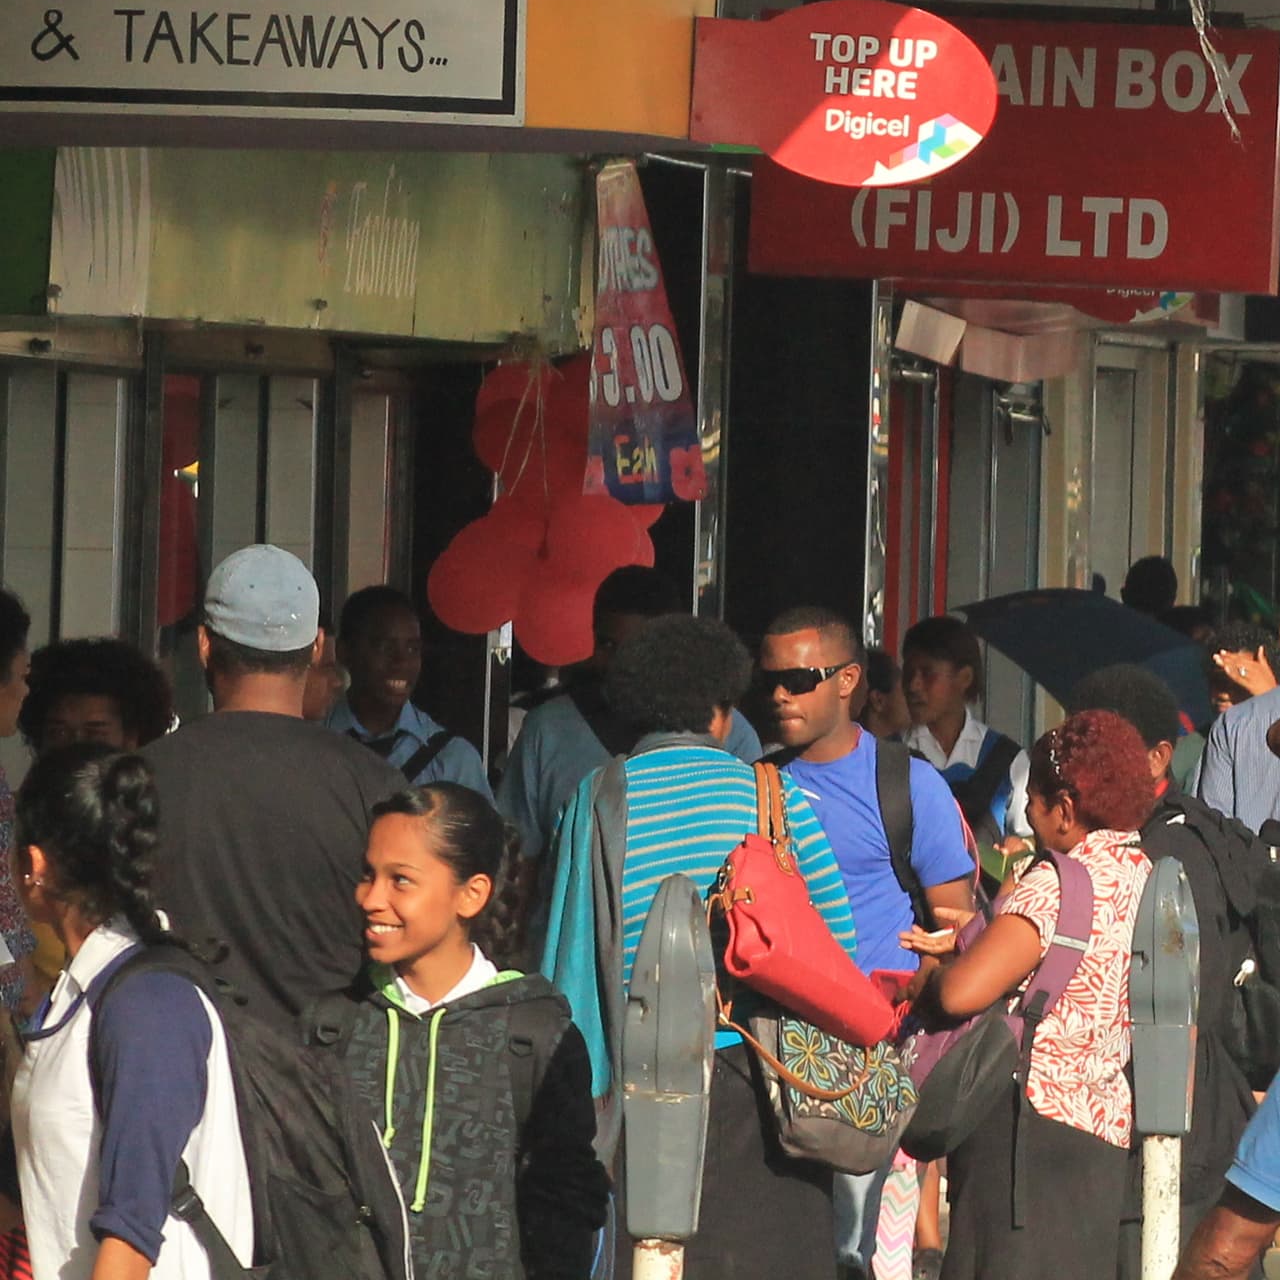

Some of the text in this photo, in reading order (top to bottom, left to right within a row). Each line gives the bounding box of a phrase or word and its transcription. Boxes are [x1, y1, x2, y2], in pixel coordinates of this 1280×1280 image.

[31, 9, 79, 61] &
[810, 32, 938, 69] TOP UP
[825, 66, 918, 101] HERE
[1115, 48, 1253, 115] BOX
[825, 109, 910, 140] Digicel
[850, 188, 1170, 261] (FIJI) LTD
